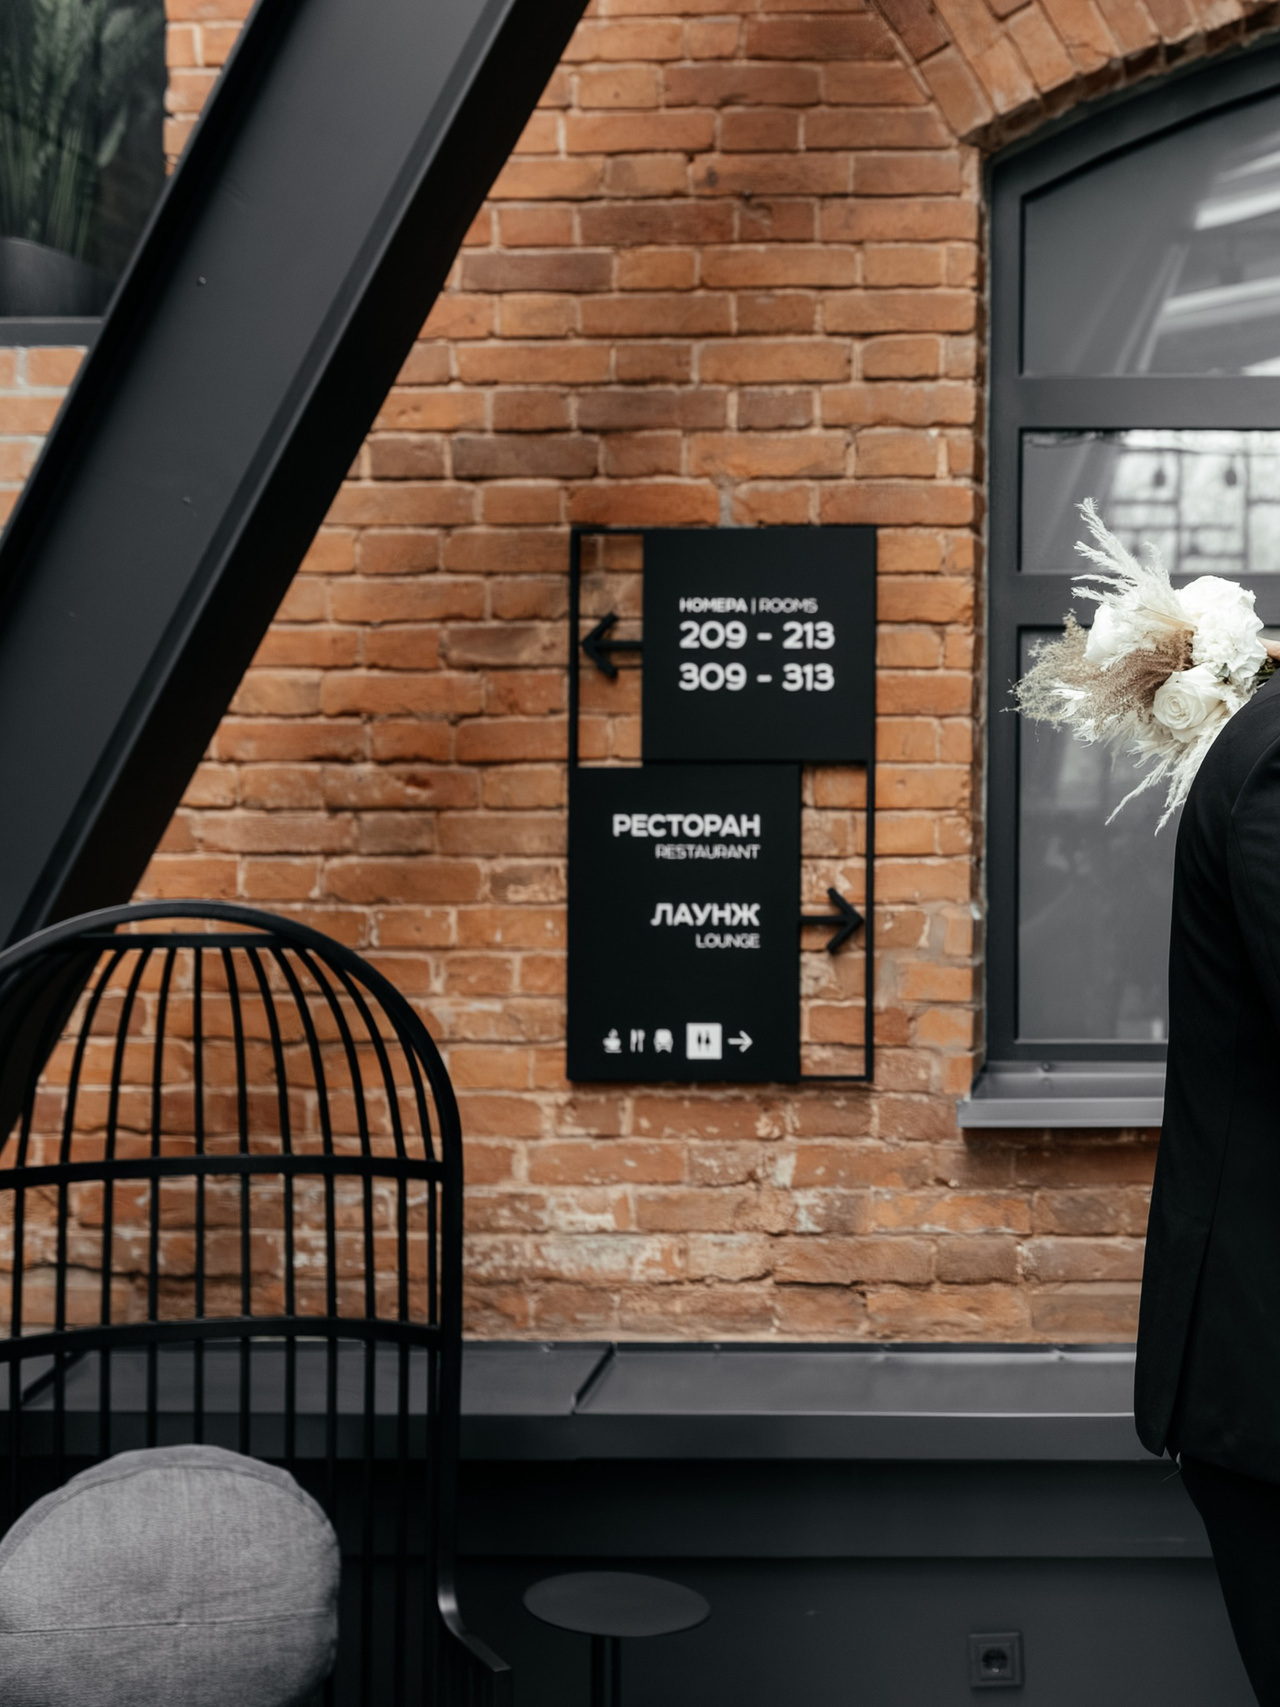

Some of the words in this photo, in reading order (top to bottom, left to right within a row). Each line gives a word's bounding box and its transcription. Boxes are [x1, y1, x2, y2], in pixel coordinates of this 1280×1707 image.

[679, 597, 748, 614] НОМЕРА
[758, 597, 819, 614] ROOMS
[679, 620, 748, 649] 209
[782, 621, 836, 650] 213
[678, 662, 747, 691] 309
[782, 662, 835, 692] 313
[612, 813, 761, 838] РЕСТОРАН
[655, 843, 761, 859] RESTAURANT
[650, 902, 761, 927] ЛАУНЖ
[695, 932, 761, 949] LOUNGE
